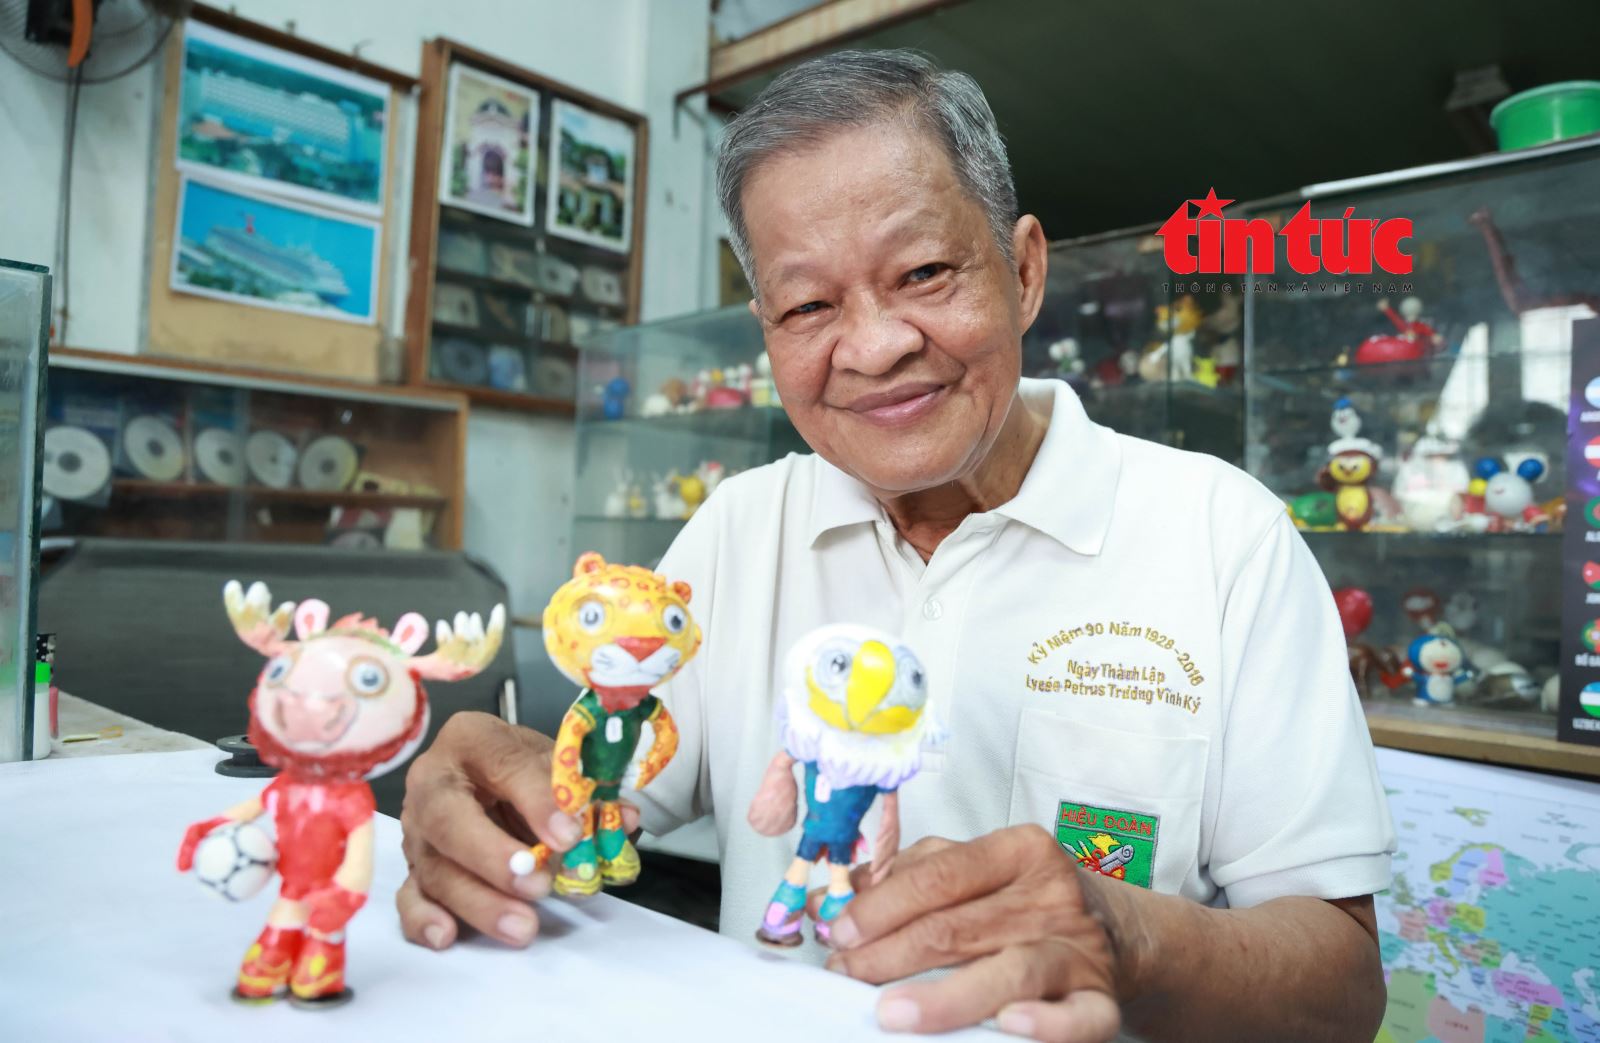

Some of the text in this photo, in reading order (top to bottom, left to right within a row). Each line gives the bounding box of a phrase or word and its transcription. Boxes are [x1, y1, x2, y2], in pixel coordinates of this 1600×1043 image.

[1045, 627, 1084, 650] Niệm
[1085, 622, 1104, 636] 90
[1109, 621, 1142, 637] Năm
[1067, 659, 1166, 684] Ngày Thành Lập
[1064, 679, 1106, 697] Petrus
[1183, 695, 1201, 714] Ký
[1061, 806, 1152, 836] HIỆU ĐOÀN
